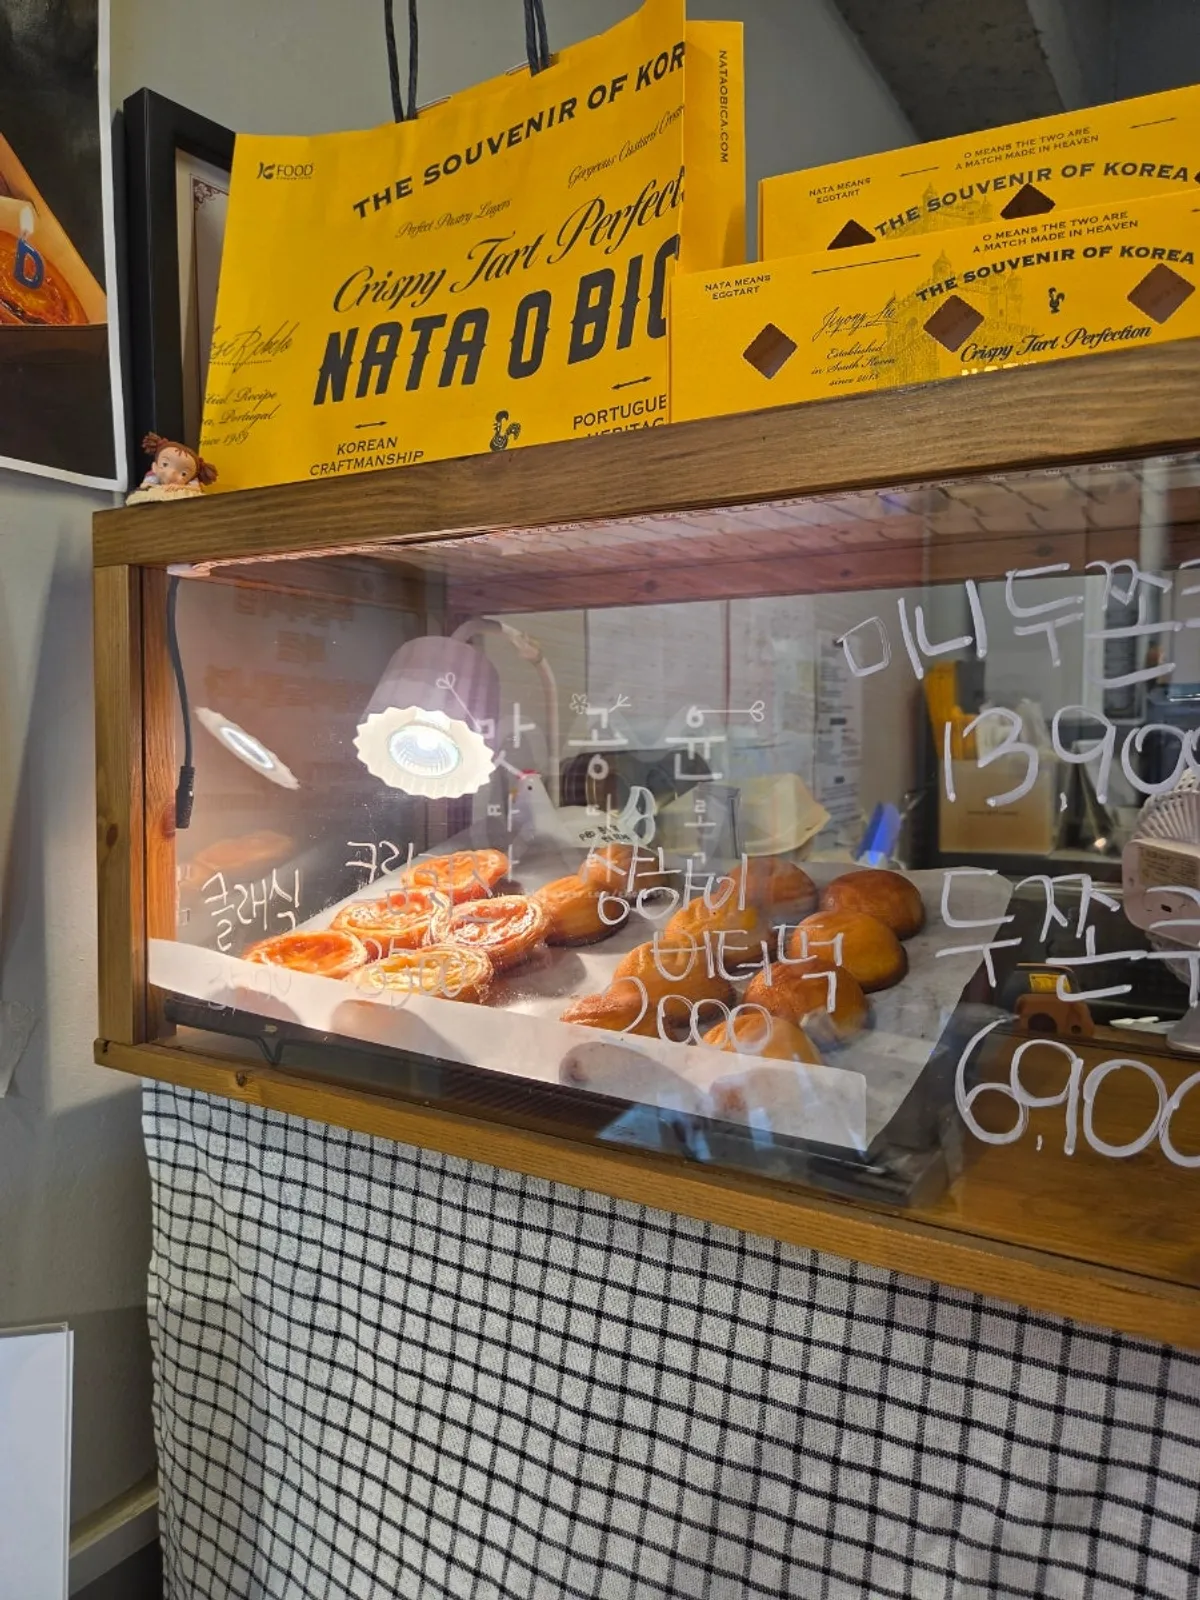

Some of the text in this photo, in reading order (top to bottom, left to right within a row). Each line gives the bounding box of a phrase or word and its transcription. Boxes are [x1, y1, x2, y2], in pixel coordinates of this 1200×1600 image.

[718, 49, 729, 163] NATAOBICA.COM
[353, 41, 685, 219] THE SOUVENIR OF KOR
[963, 127, 1091, 160] O MEANS THE TWO ARE
[955, 135, 1099, 170] A MATCH MADE IN HEAVEN
[277, 164, 314, 177] FOOD
[809, 177, 871, 198] NATA MEANS
[816, 189, 860, 205] EGGTART
[875, 162, 1189, 238] THE SOUVENIR OF KOREA
[394, 200, 512, 239] Perfect Pastry Layers
[982, 211, 1128, 242] O MEANS THE TWO ARE
[972, 220, 1139, 253] A MATCH MADE IN HEAVEN
[333, 265, 447, 313] Crispy
[449, 230, 547, 293] Tart
[704, 274, 771, 292] NATA MEANS
[916, 245, 1195, 302] THE SOUVENIR OF KOREA
[712, 285, 760, 300] EGGTART
[313, 233, 681, 406] NATA O BIC
[827, 340, 886, 359] Established
[960, 324, 1151, 364] Crispy Tart Perfection
[827, 355, 864, 372] South
[862, 357, 896, 368] Korea
[829, 378, 853, 386] since
[234, 387, 277, 411] Recipe
[573, 394, 667, 430] PORTUGUE
[219, 403, 281, 429] Portugal
[336, 436, 398, 456] KOREAN
[309, 450, 424, 476] CRAFTMANSHIP
[200, 867, 300, 952] 클래식
